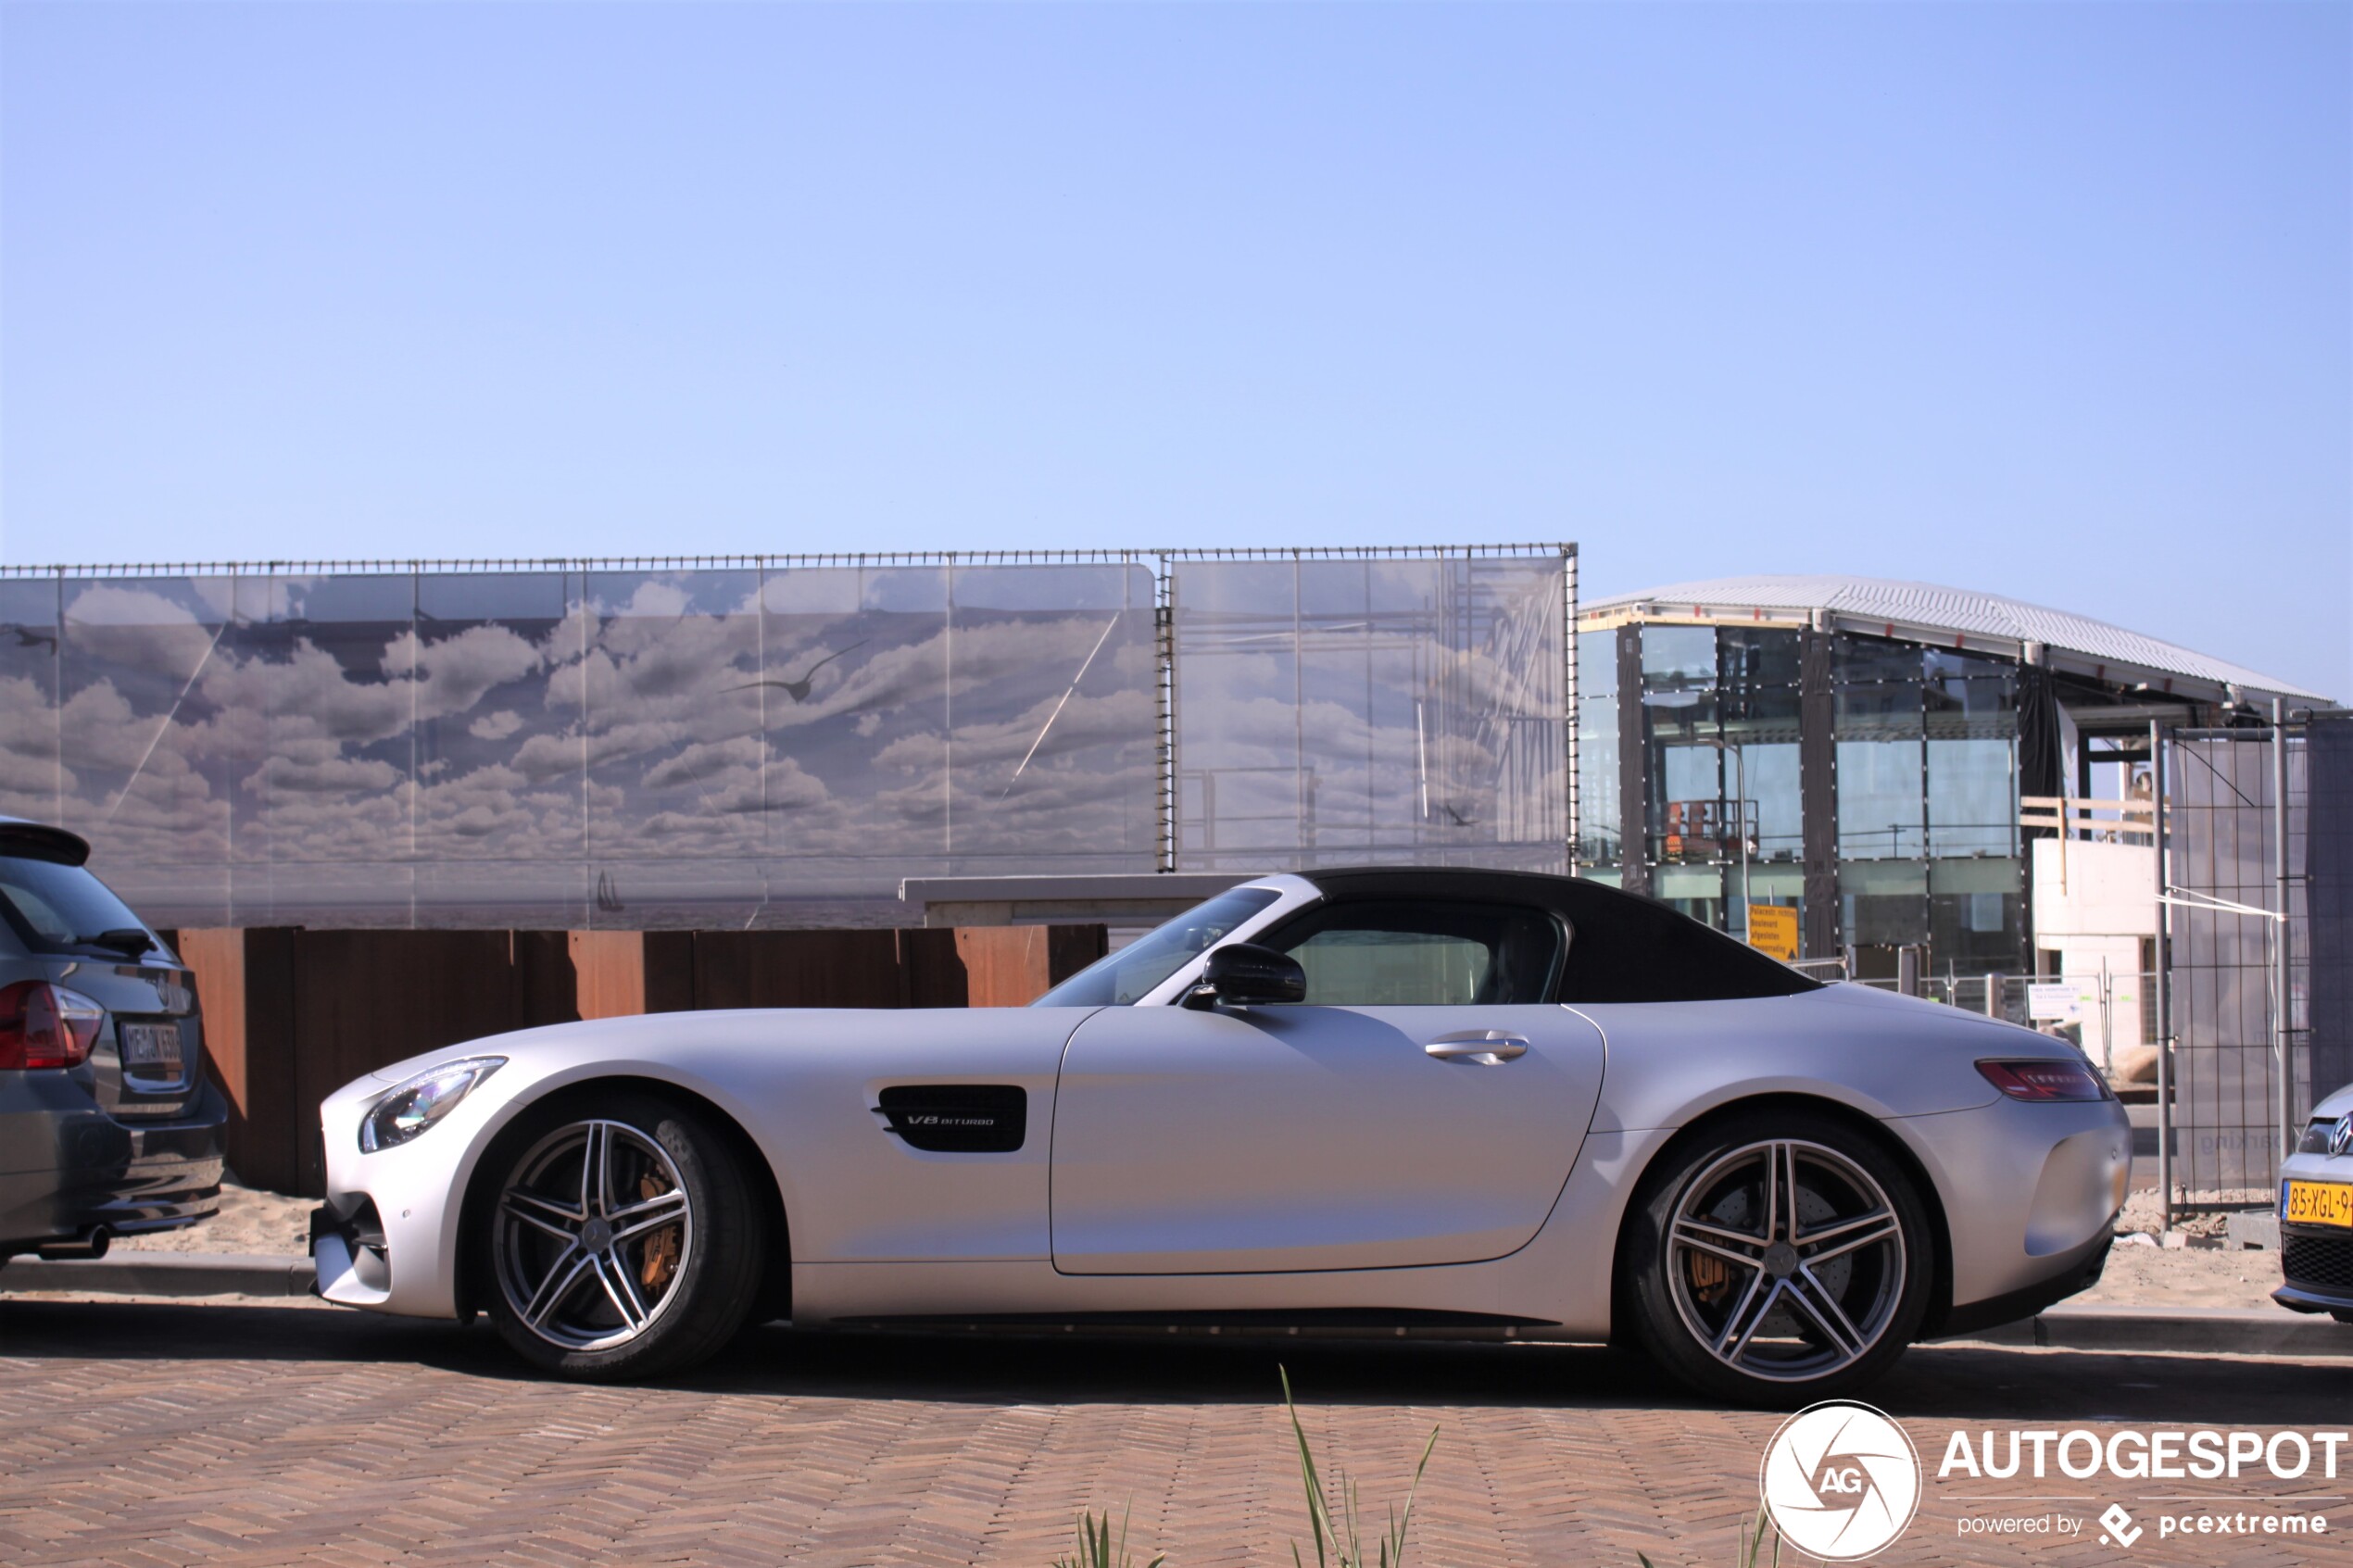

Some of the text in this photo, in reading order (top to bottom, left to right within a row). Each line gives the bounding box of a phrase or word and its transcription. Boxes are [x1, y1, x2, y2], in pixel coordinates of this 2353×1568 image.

[1750, 919, 1778, 928] Boulevard
[907, 1115, 994, 1126] V8 BITURBO
[2290, 1186, 2348, 1220] 85-XGL-9
